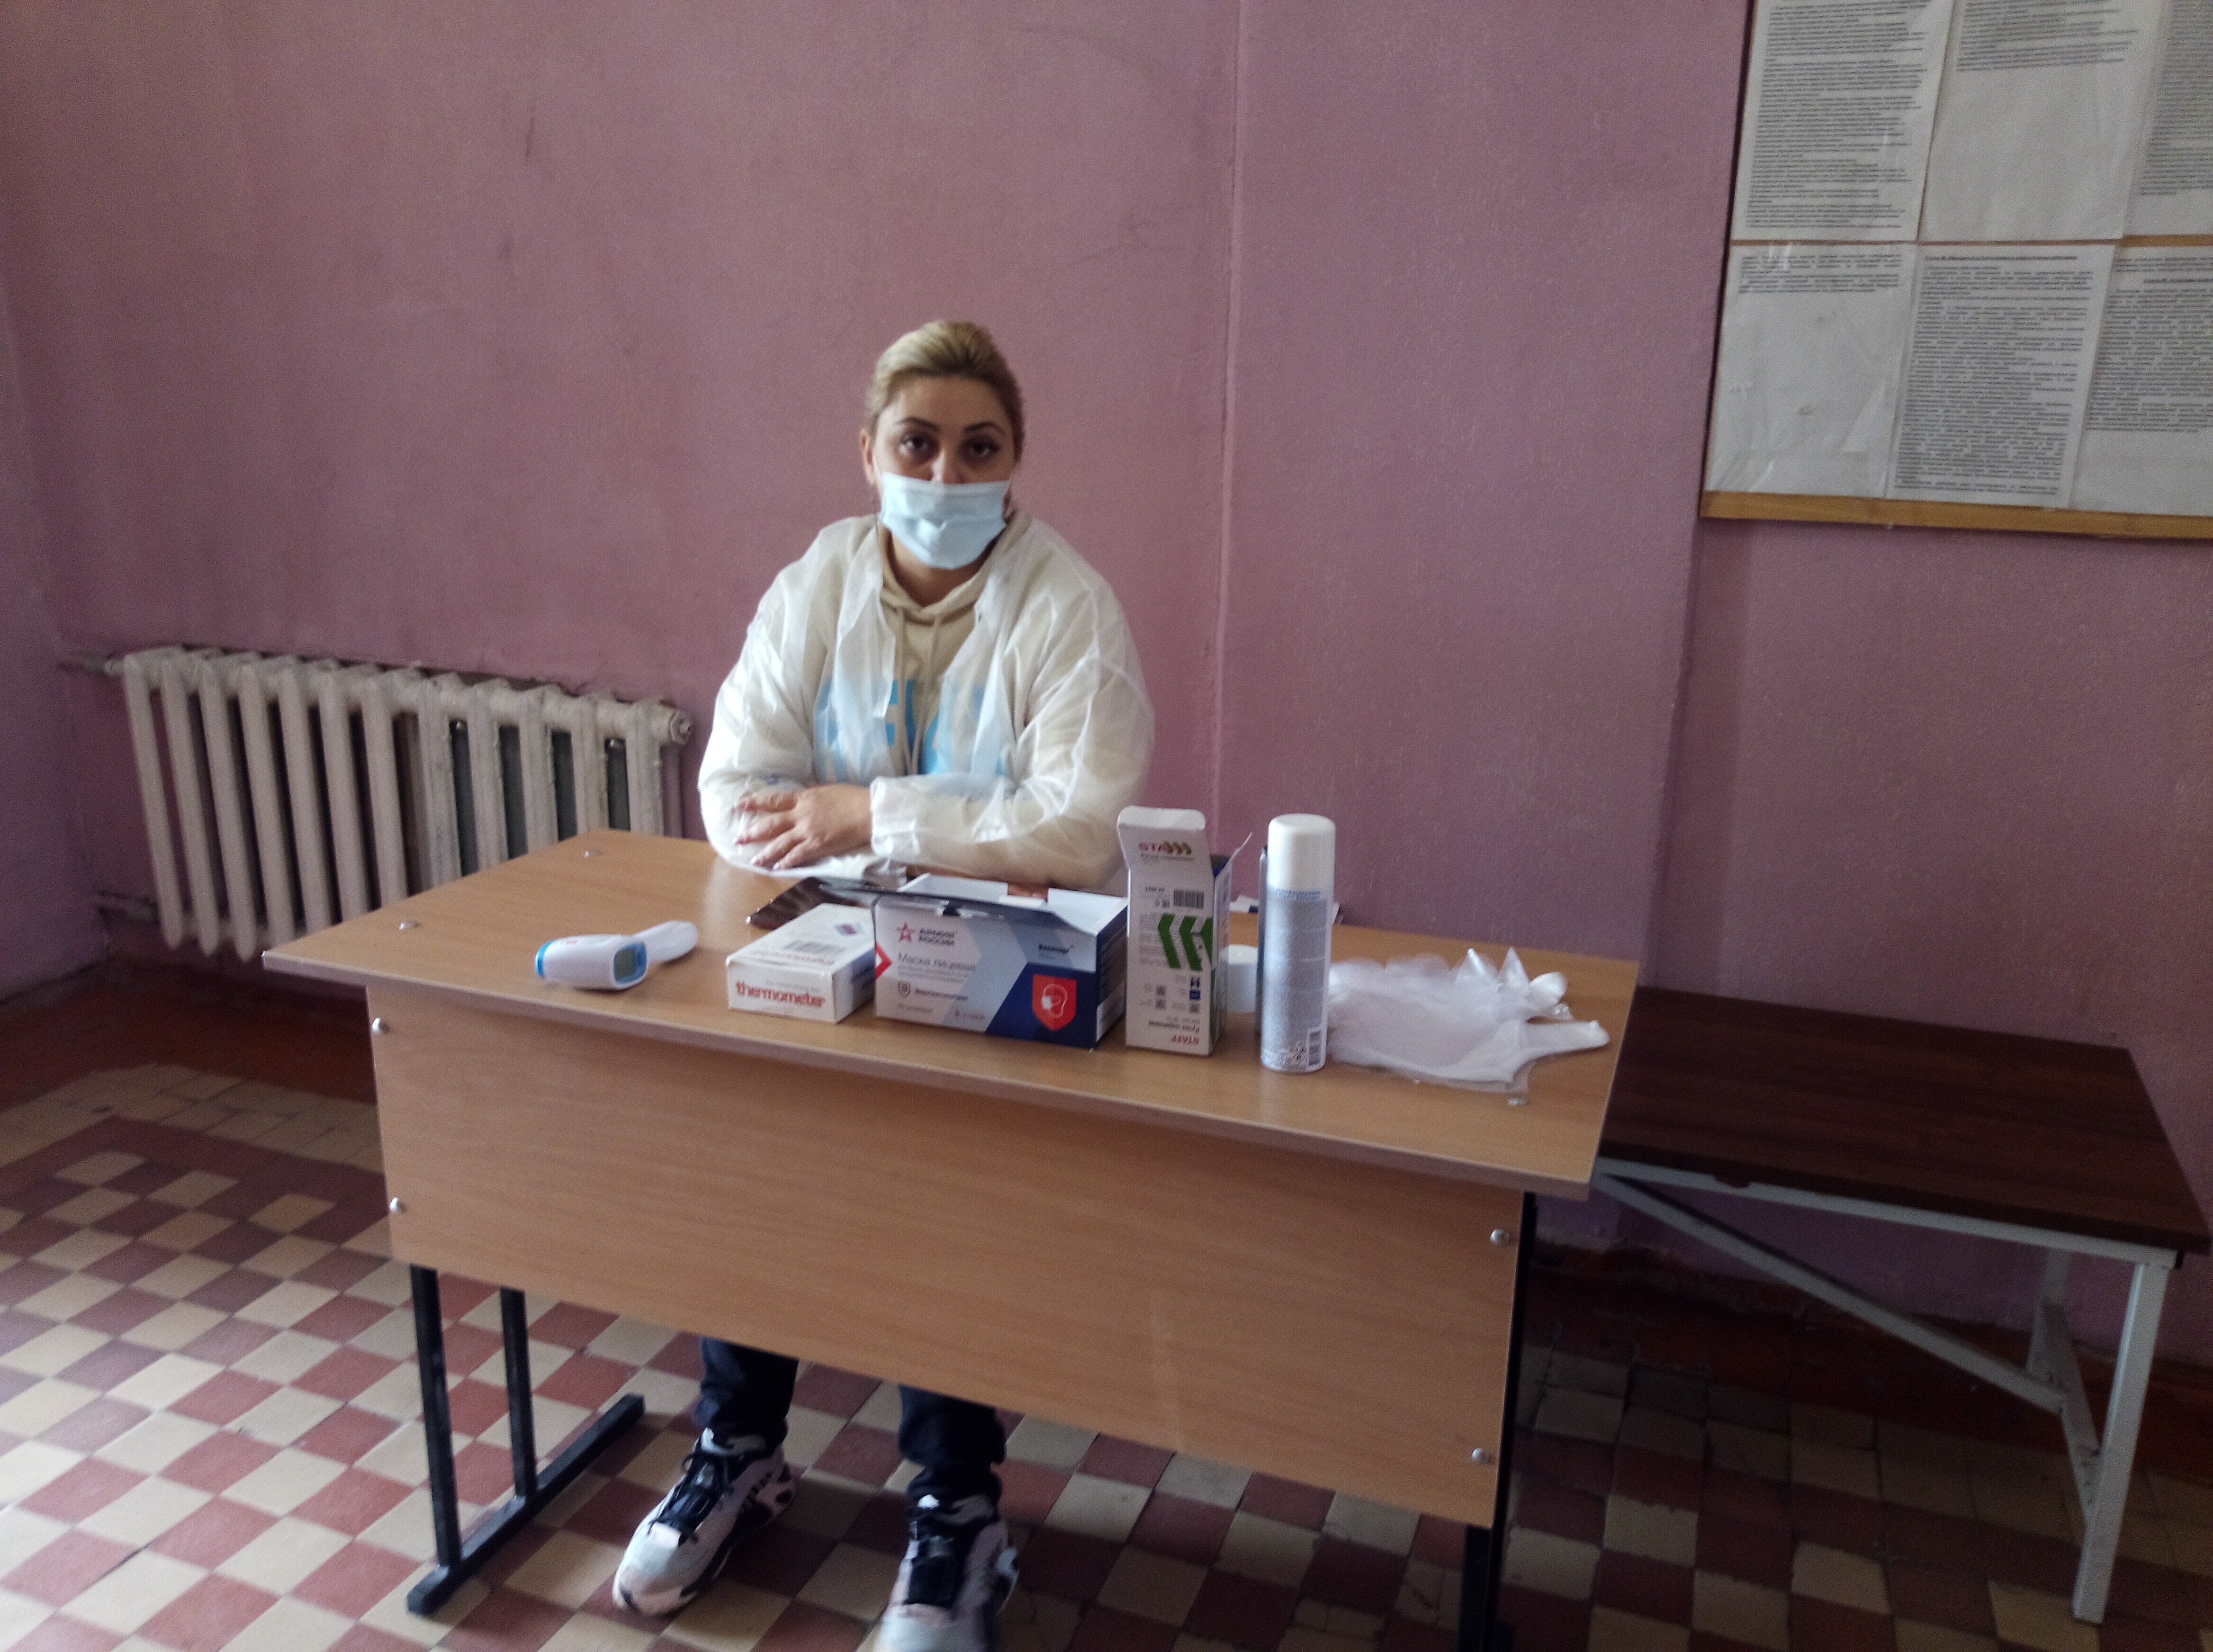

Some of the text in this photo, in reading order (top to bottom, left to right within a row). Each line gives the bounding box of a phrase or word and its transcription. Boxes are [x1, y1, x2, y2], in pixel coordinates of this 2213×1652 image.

[899, 952, 976, 971] Маска лицевая
[736, 980, 826, 1007] thermometer
